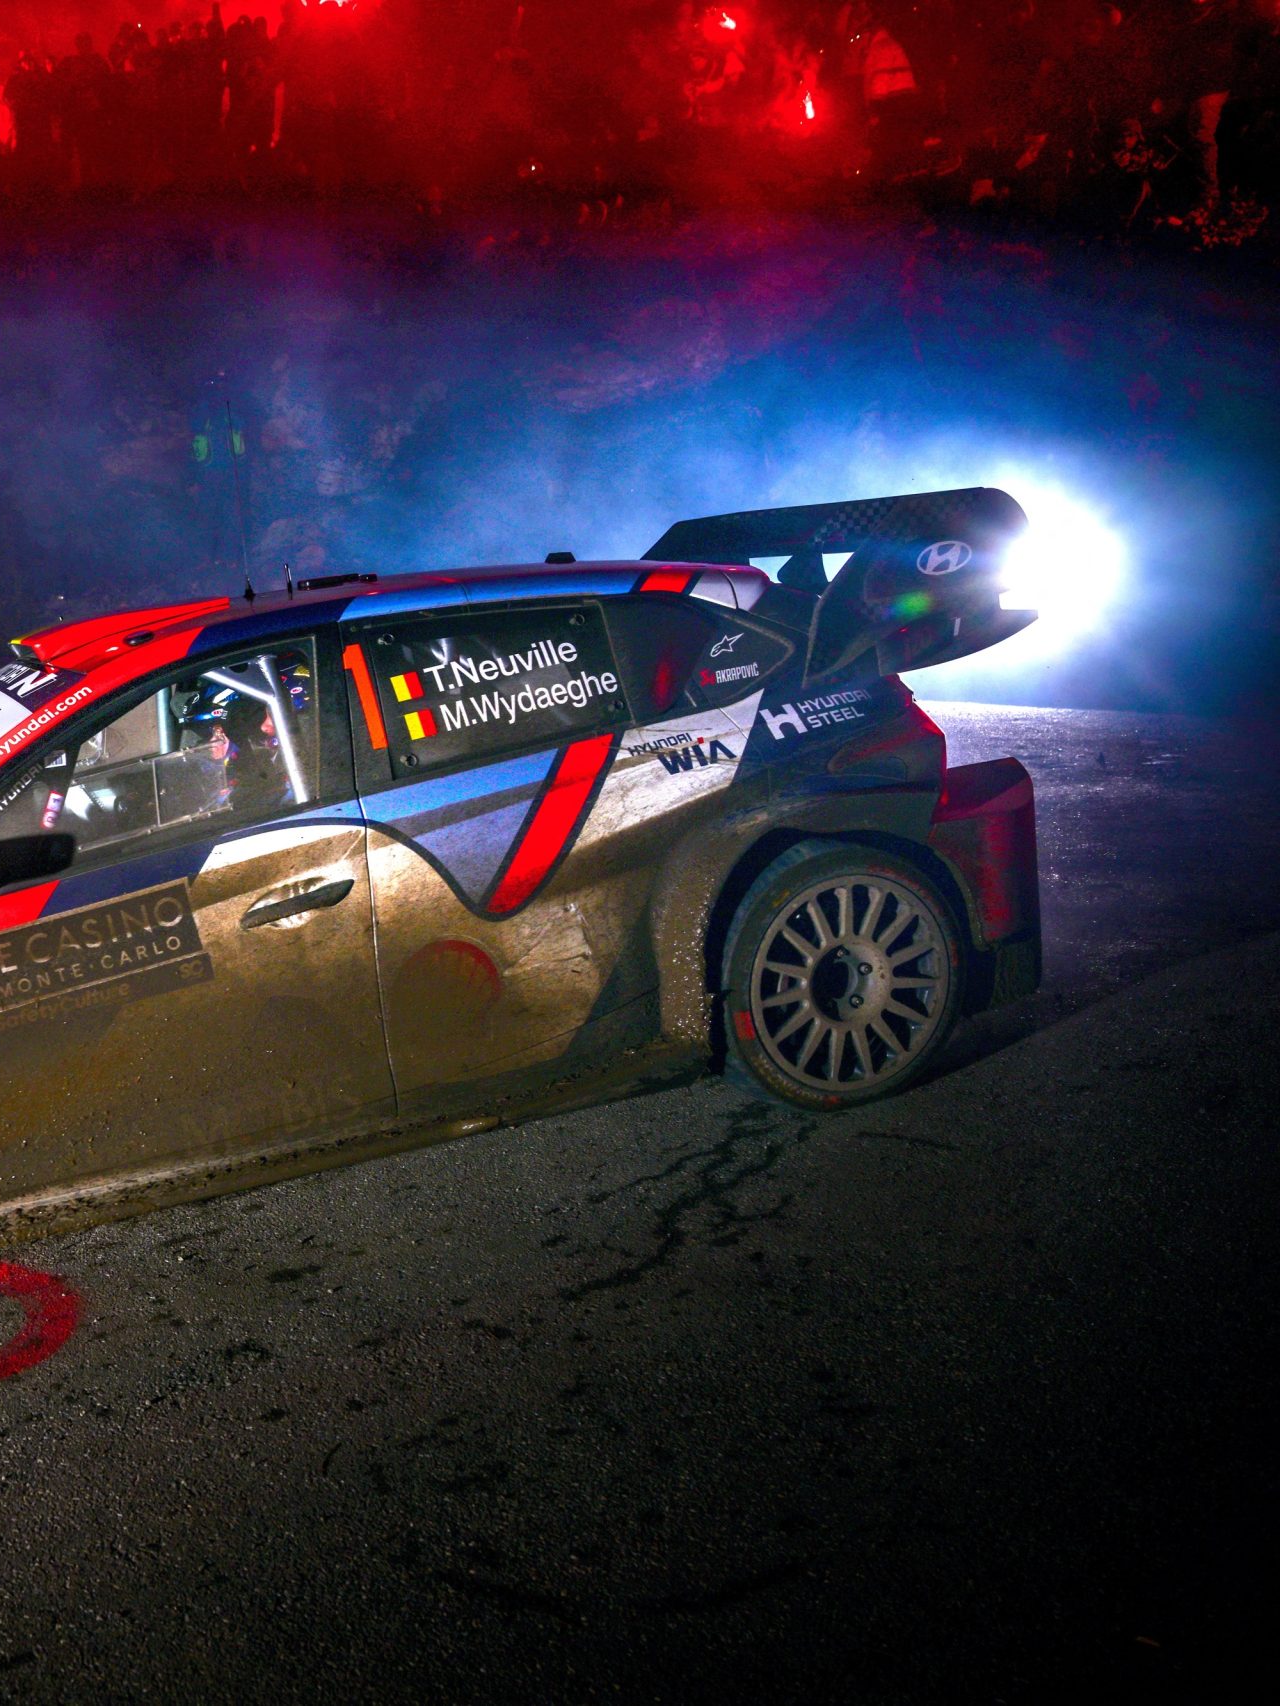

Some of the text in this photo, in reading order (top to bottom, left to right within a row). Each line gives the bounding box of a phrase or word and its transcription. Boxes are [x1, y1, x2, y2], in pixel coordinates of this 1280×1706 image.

[423, 639, 578, 693] T.Neuville
[342, 643, 389, 750] 1
[439, 671, 618, 731] M.Wydaeghe
[797, 689, 872, 714] HYUNDAI
[807, 706, 865, 729] STEEL
[627, 732, 693, 757] HYUNDAI
[25, 896, 184, 965] CASINO
